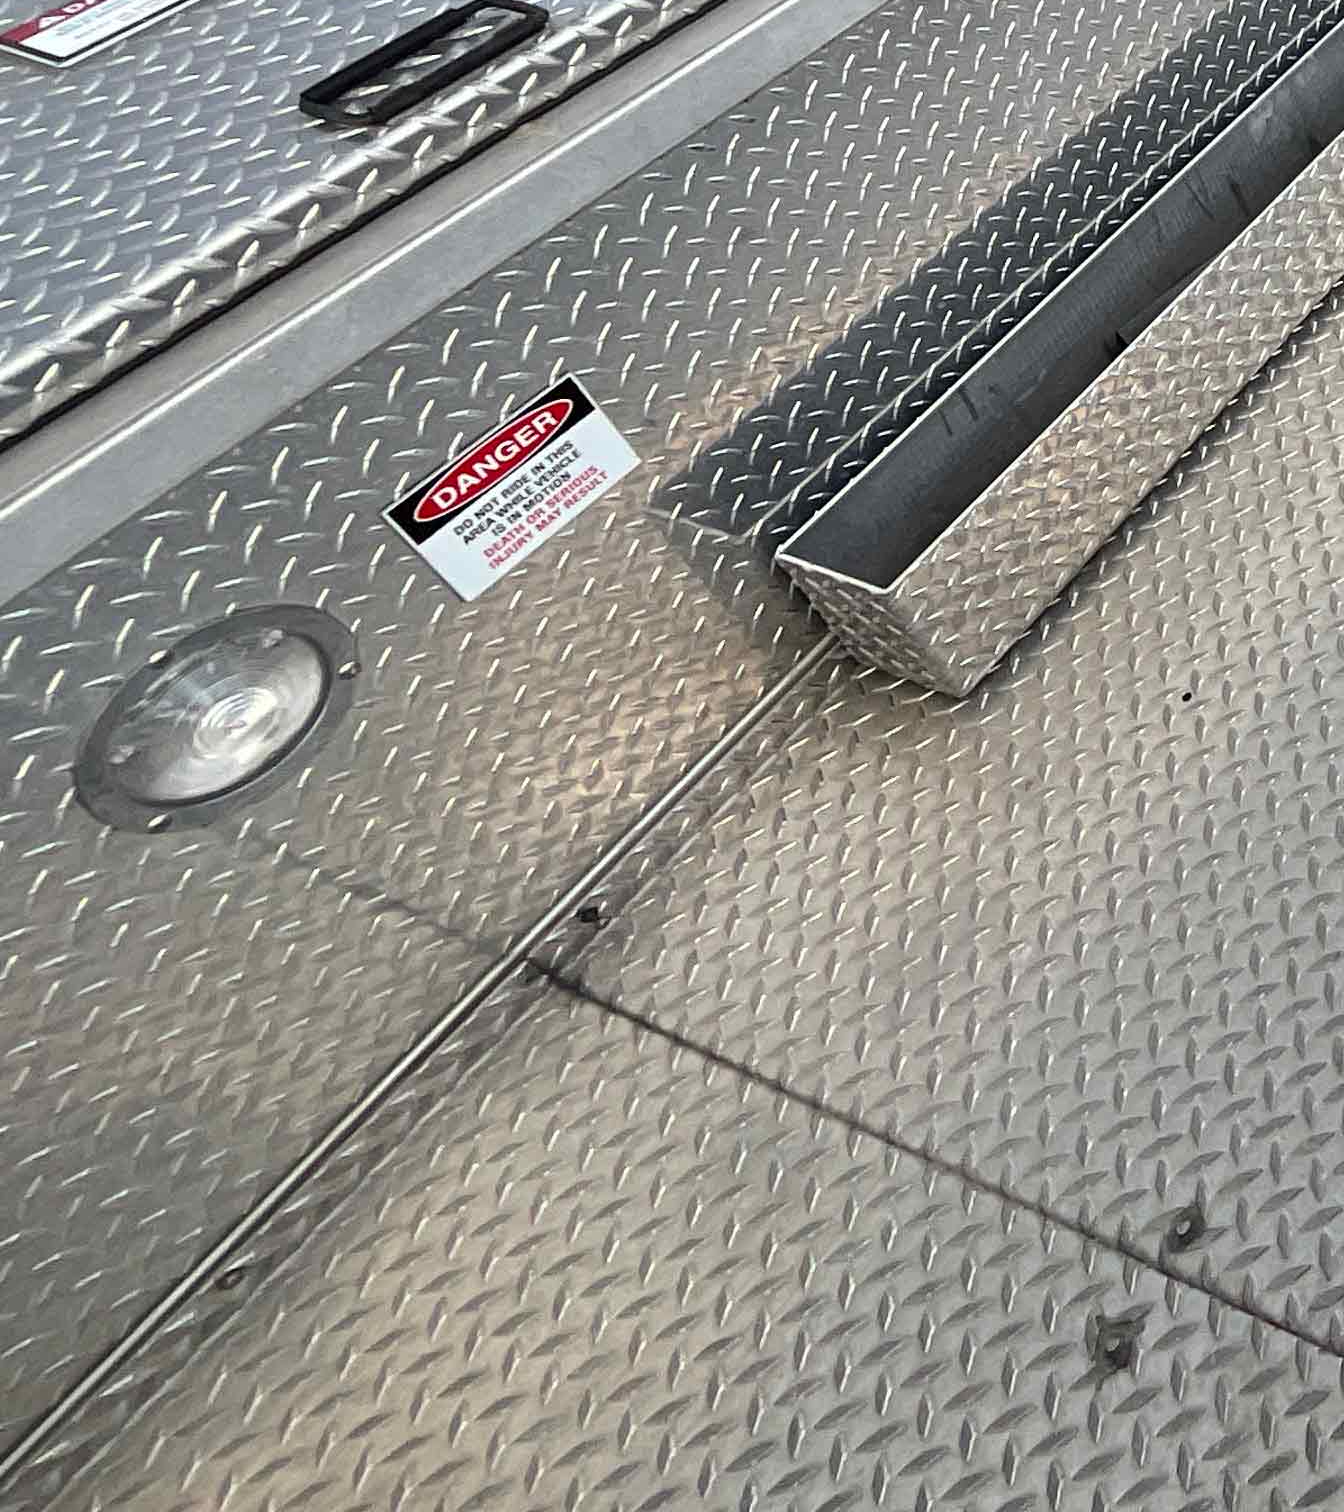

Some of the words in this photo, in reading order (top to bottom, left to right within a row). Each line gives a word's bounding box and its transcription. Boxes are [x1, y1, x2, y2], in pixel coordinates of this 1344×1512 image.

[430, 410, 560, 511] DANGER
[453, 518, 474, 536] DO
[474, 496, 501, 520] NOT
[501, 474, 530, 499] RIDE
[530, 462, 546, 477] IN
[545, 440, 574, 464] THIS
[462, 517, 496, 545] AREA
[495, 486, 535, 517] WHILE
[534, 449, 582, 486] VEHICLE
[491, 523, 507, 537] IS
[507, 510, 523, 524] IN
[522, 472, 573, 512] MOTION
[483, 523, 526, 558] DEATH
[526, 507, 547, 524] OR
[545, 465, 598, 509] SERIOUS
[488, 530, 535, 569] INJURY
[535, 507, 563, 532] MAY
[563, 469, 609, 510] RESULT
